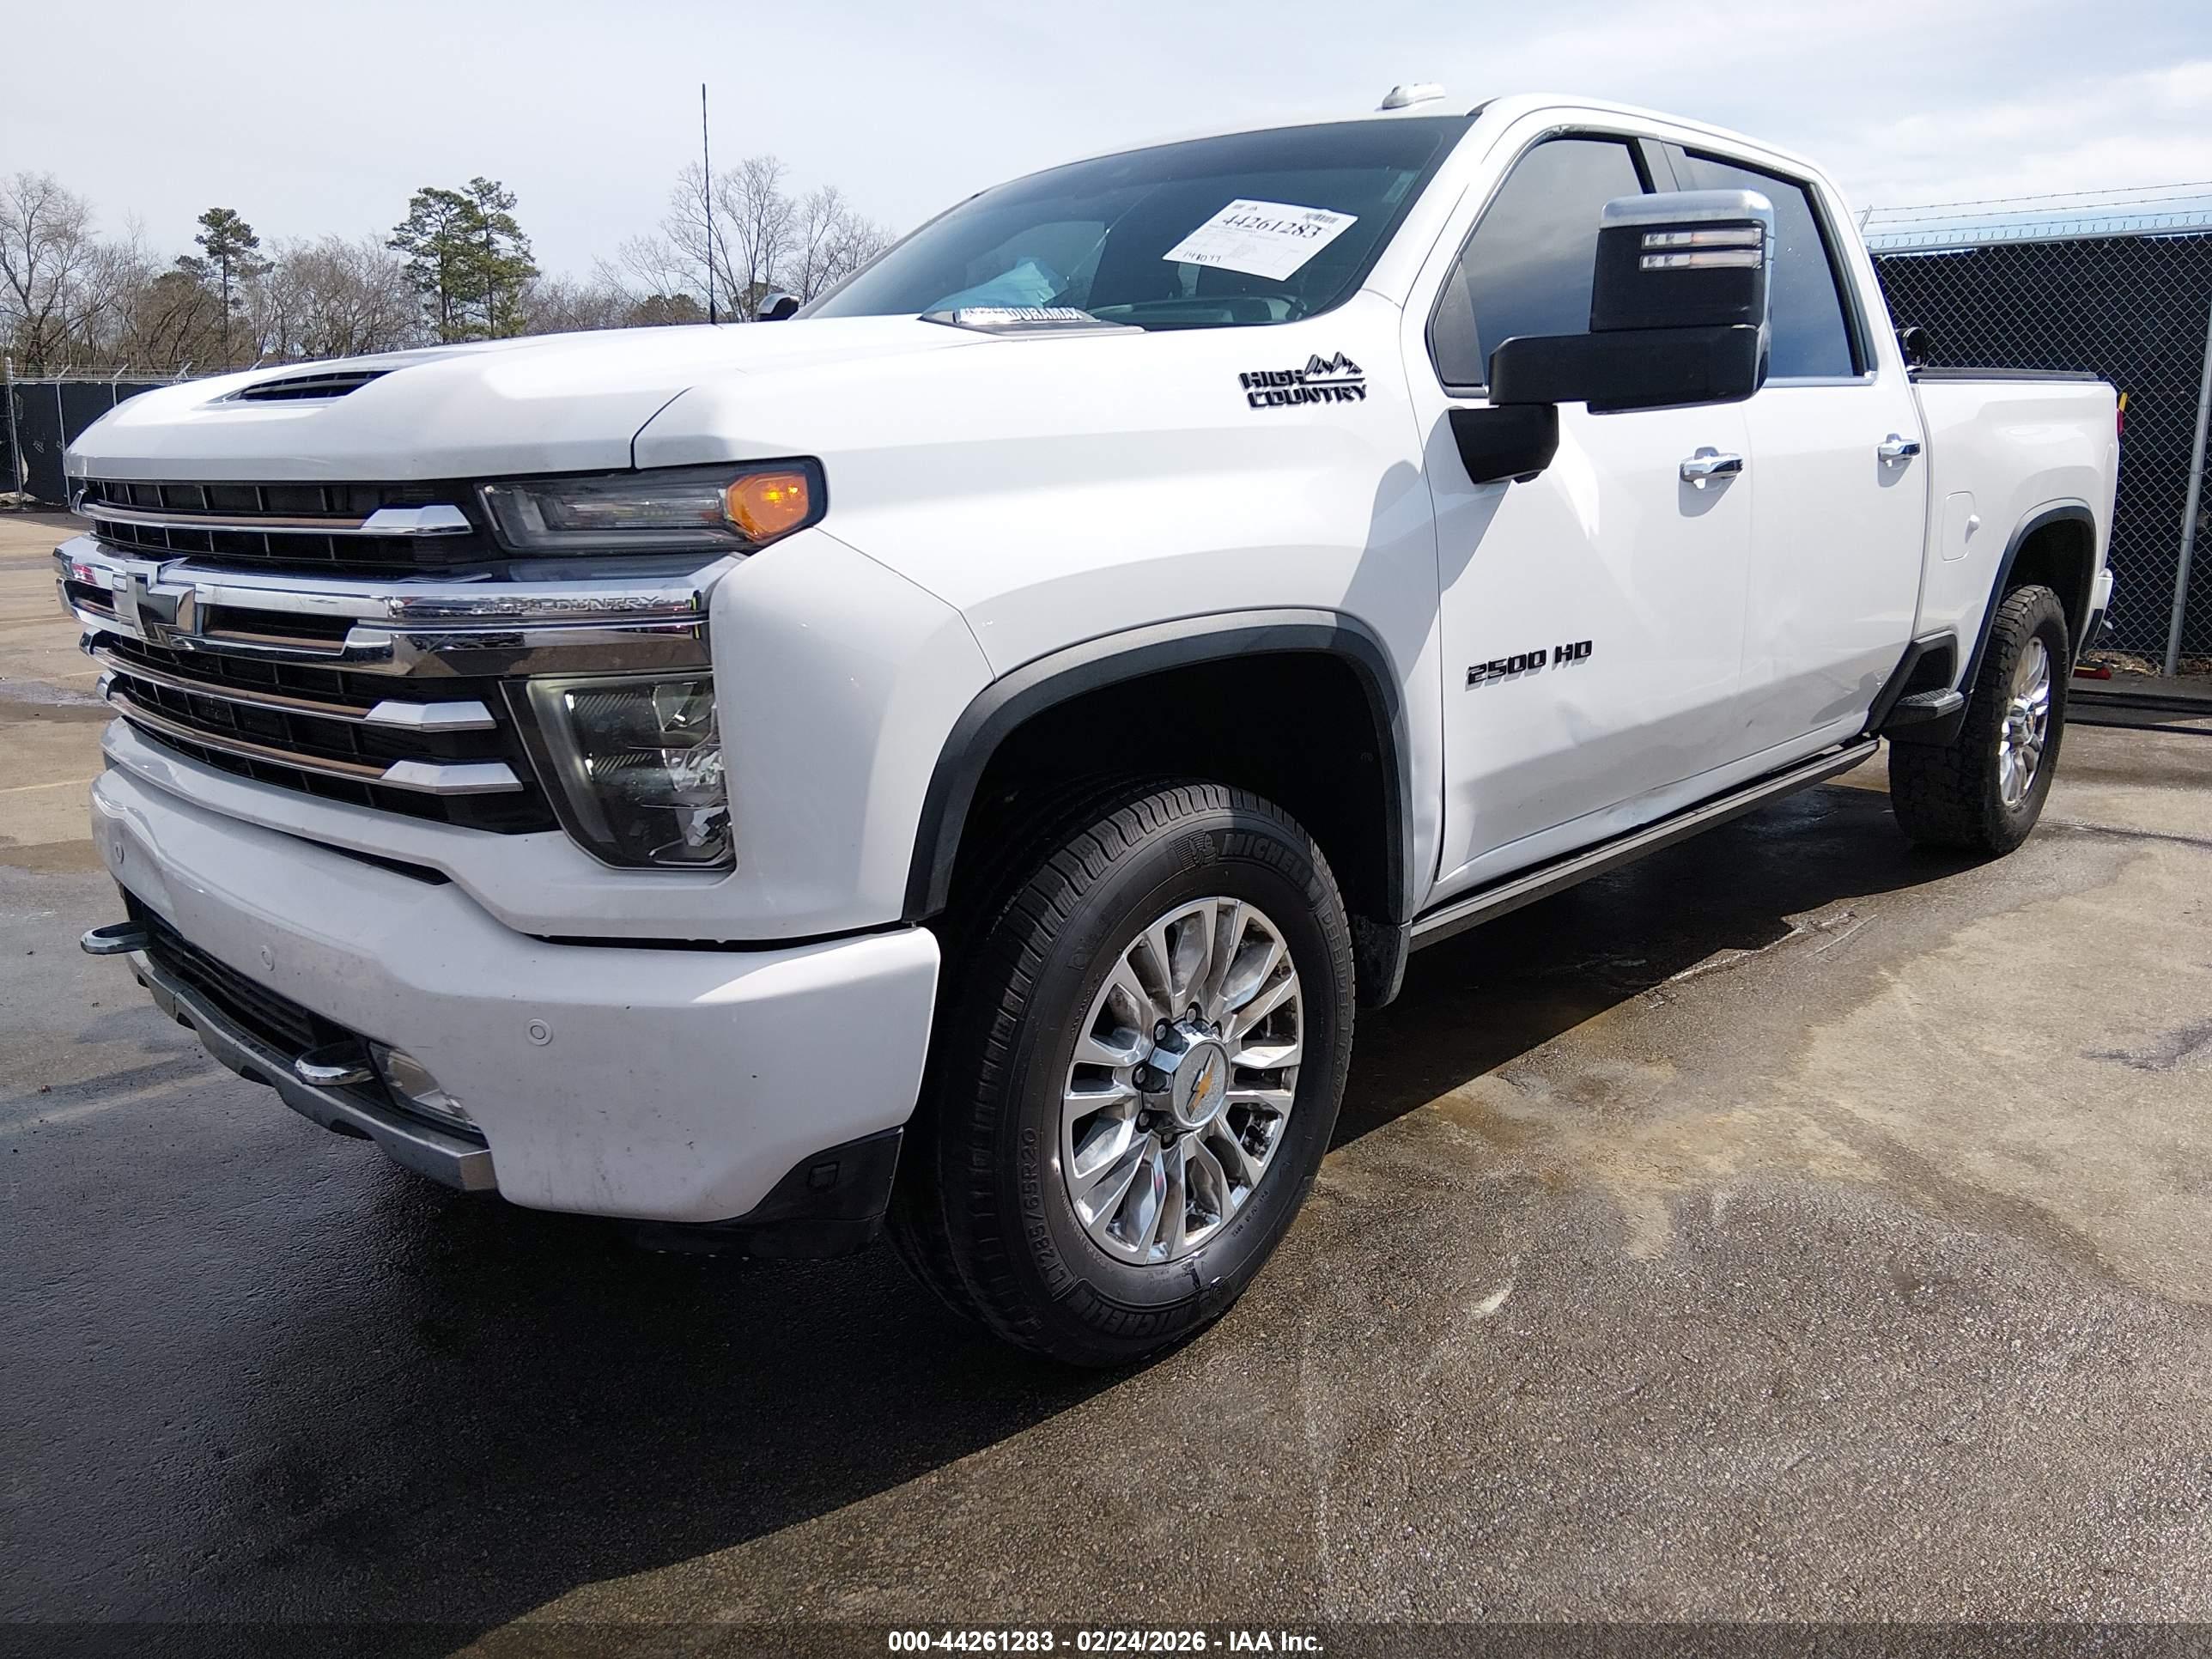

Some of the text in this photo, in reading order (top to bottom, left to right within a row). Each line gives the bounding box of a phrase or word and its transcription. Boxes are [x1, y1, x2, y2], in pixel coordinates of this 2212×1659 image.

[1223, 213, 1322, 239] 44261283
[1238, 369, 1306, 392] HIGH
[1248, 385, 1368, 410] COUNTRY
[1467, 640, 1593, 686] 2500 HD
[1222, 833, 1325, 902] MICHELIN
